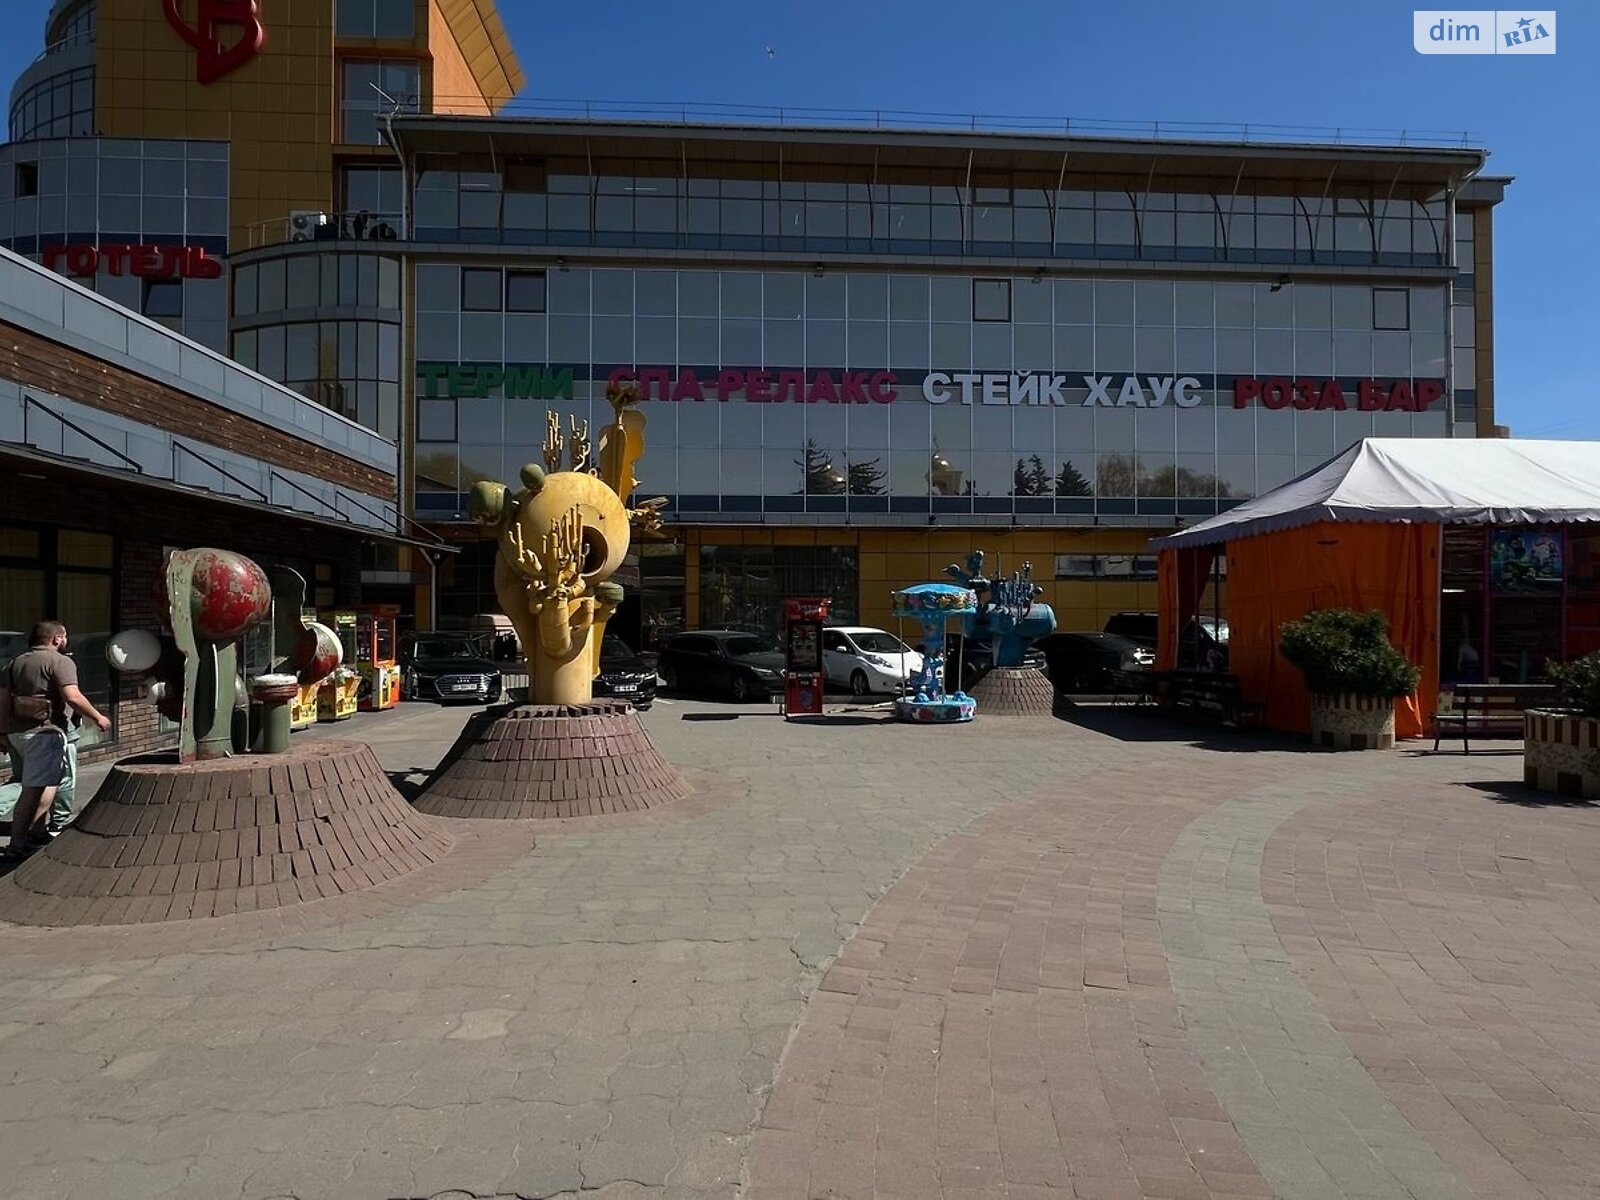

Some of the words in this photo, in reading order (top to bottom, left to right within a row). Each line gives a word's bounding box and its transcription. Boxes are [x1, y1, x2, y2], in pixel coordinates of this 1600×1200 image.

[42, 243, 222, 279] ГОТЕЛЬ
[417, 365, 573, 400] ТЕРМИ
[922, 370, 1066, 405] СТЕЙК
[1082, 375, 1202, 408] ХАУС
[1233, 377, 1347, 411] РОЗА
[1356, 379, 1444, 412] БАР
